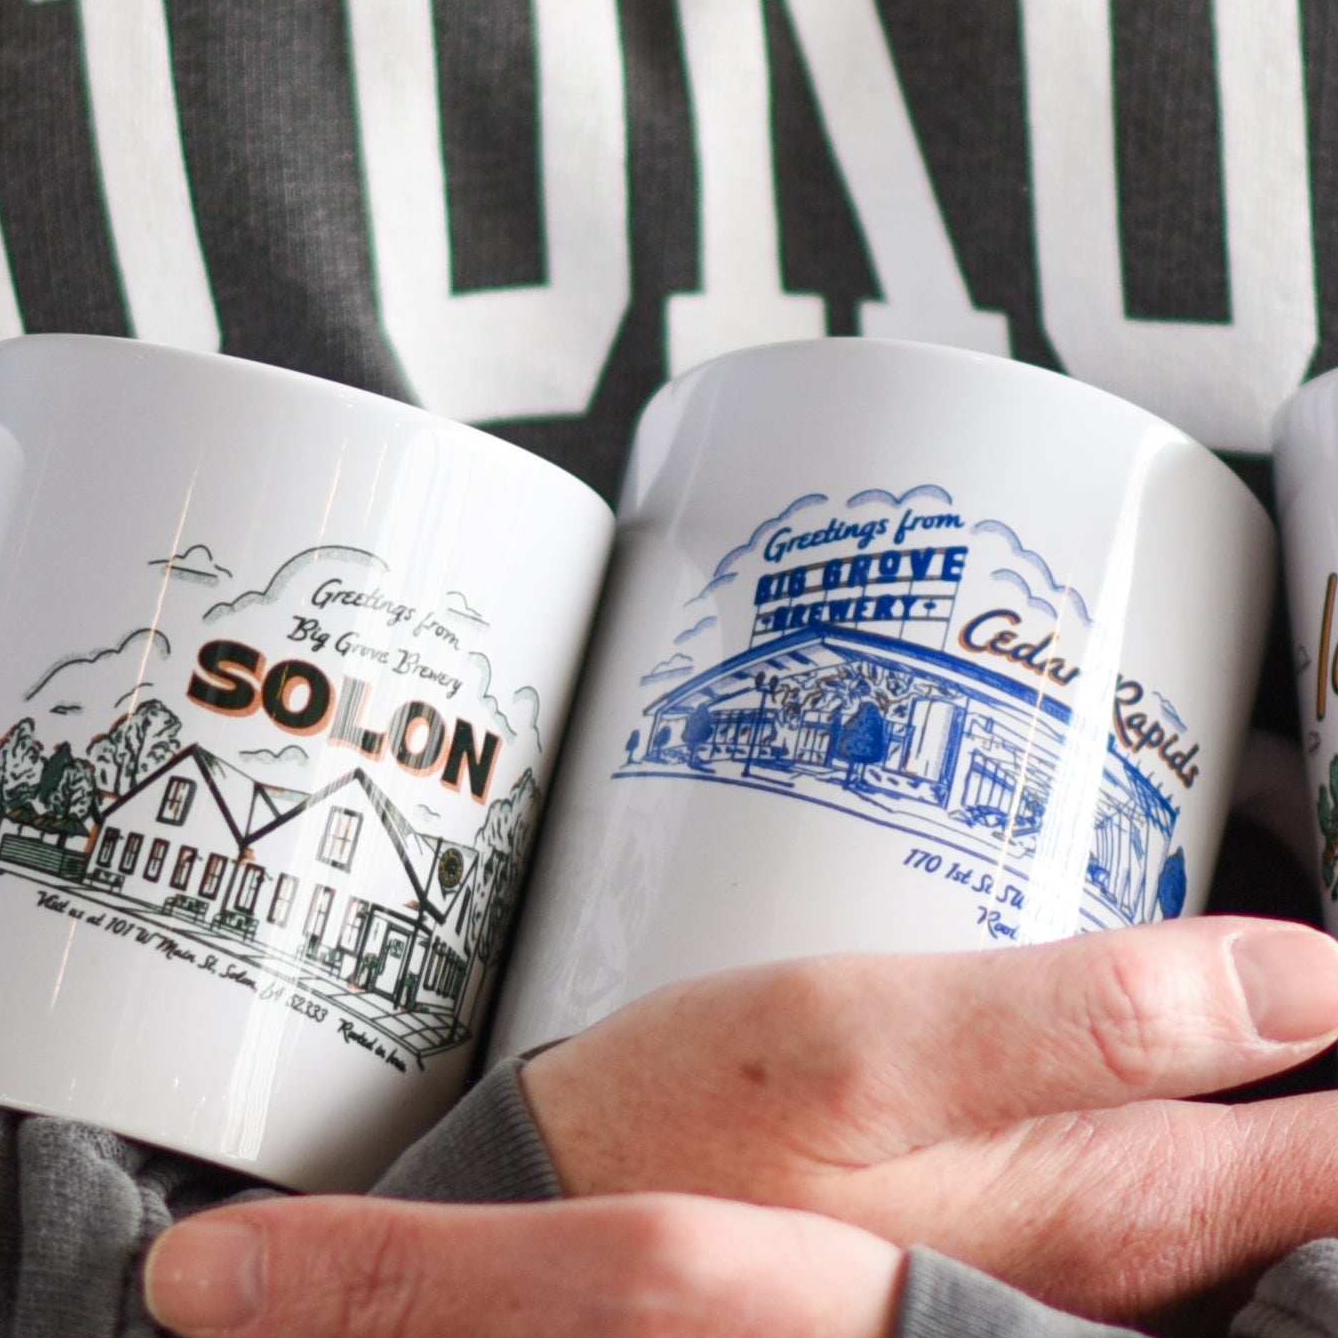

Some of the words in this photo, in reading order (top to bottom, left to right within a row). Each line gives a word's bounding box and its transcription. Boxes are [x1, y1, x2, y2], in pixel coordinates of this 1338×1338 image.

[763, 518, 889, 563] Greetings
[893, 509, 965, 545] from
[754, 566, 807, 606] BIG
[822, 546, 969, 591] GROVE
[311, 578, 417, 627] Greetings
[413, 611, 461, 651] from
[286, 615, 331, 652] Big
[334, 631, 390, 664] Grove
[392, 647, 463, 699] Brewery
[187, 639, 503, 805] SOLON
[958, 608, 1082, 687] Ceda
[1111, 672, 1200, 789] Rapids
[903, 848, 943, 873] 170
[945, 862, 973, 884] 1st
[68, 908, 84, 921] us
[86, 913, 103, 928] at
[104, 917, 132, 938] 101
[133, 927, 157, 945] W
[155, 935, 196, 963] Main
